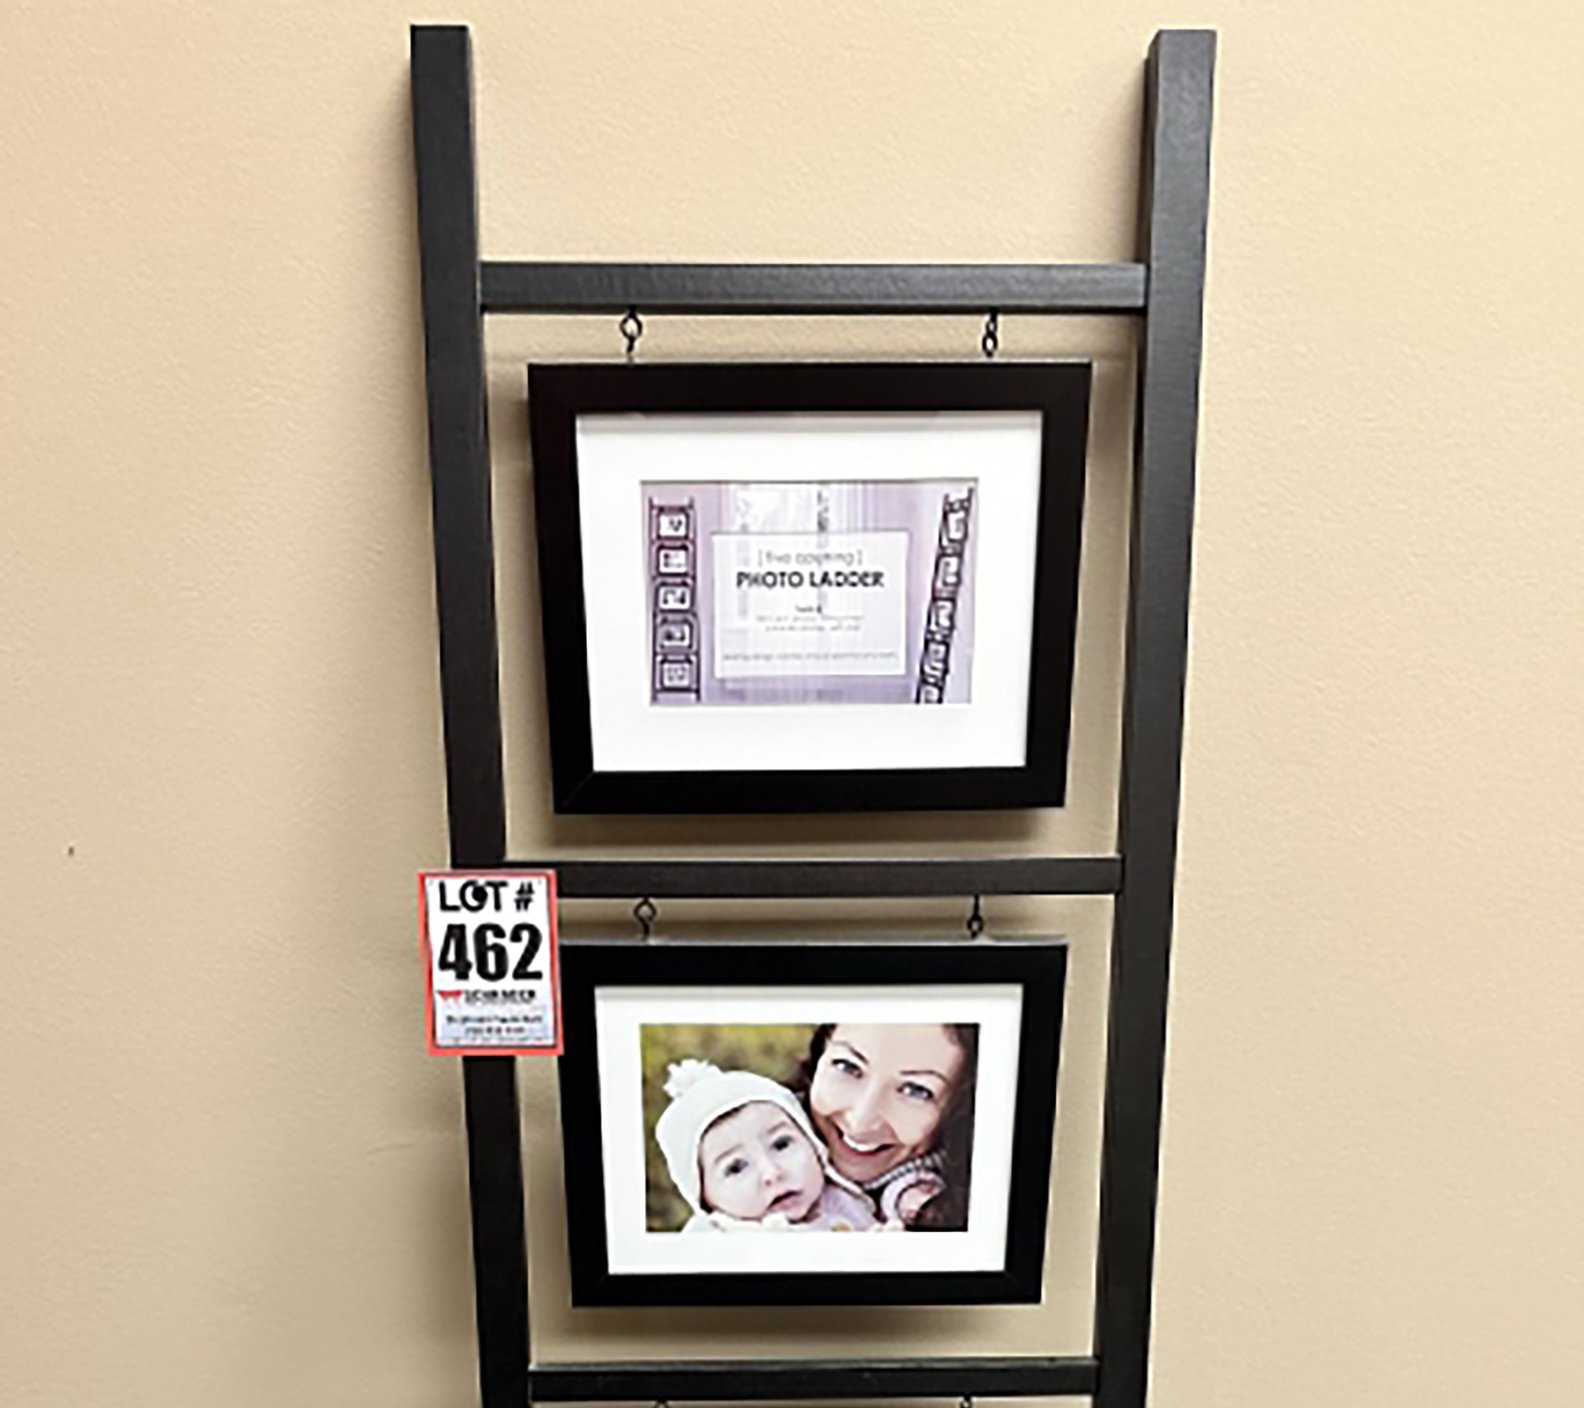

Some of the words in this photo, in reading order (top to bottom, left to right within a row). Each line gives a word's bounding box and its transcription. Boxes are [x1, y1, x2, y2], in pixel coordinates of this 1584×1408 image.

[736, 571, 804, 588] PHOTO
[809, 571, 885, 588] LADDER
[438, 879, 509, 913] LOT
[513, 880, 536, 912] #
[438, 922, 544, 982] 462
